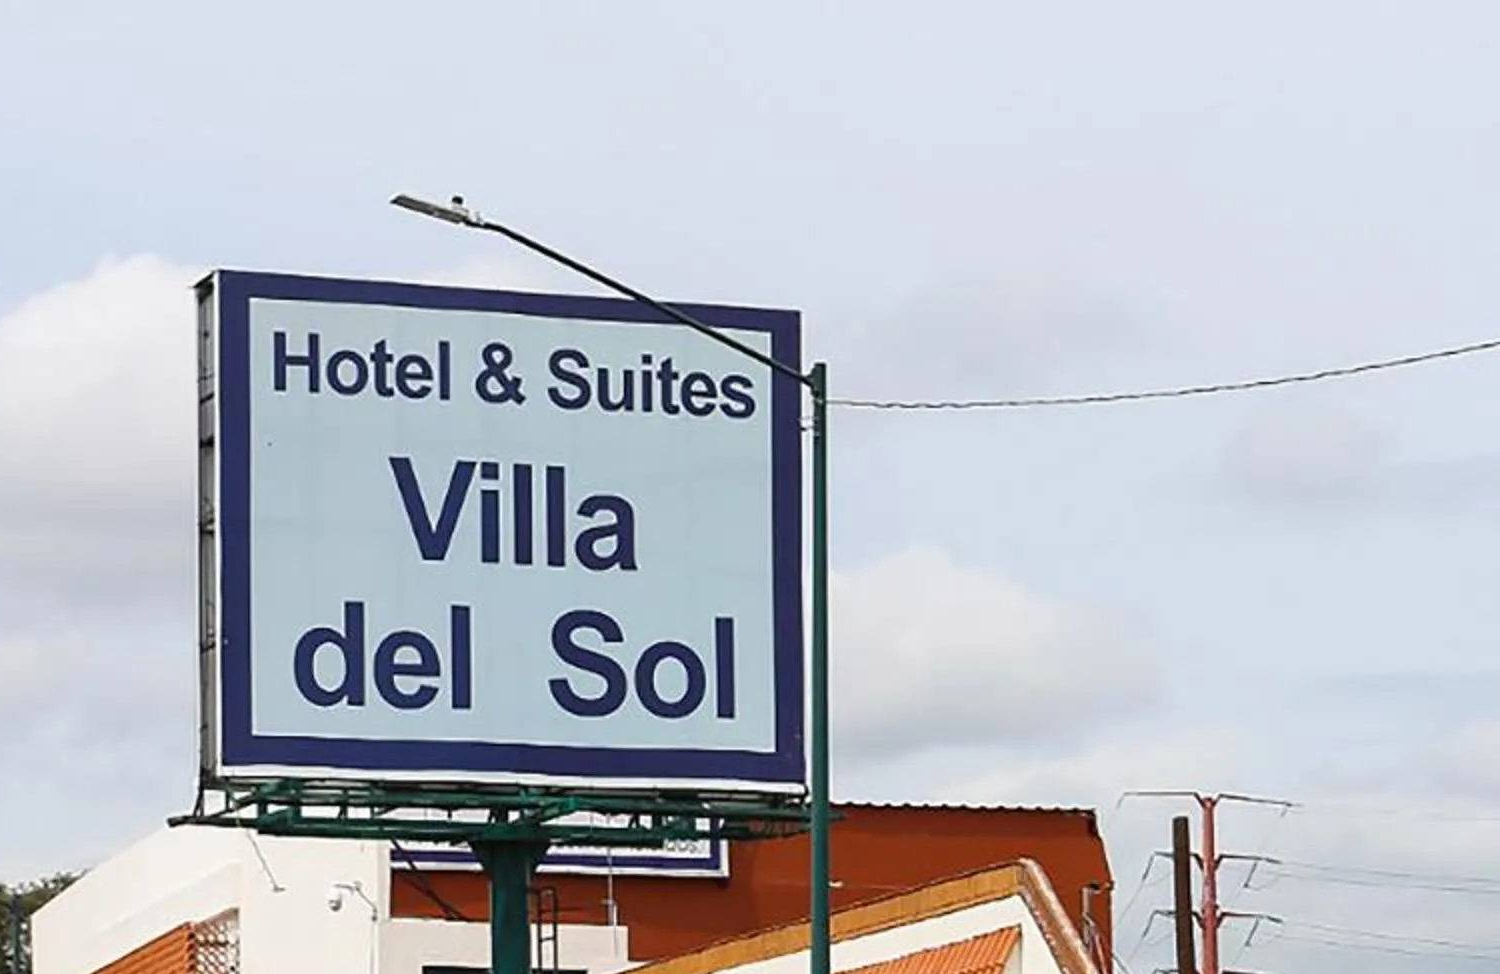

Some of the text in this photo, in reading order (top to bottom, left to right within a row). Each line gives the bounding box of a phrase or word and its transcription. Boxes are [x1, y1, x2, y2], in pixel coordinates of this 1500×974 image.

[274, 332, 756, 418] Hotel & Suites
[389, 457, 637, 571] Villa
[294, 601, 735, 719] del Sol
